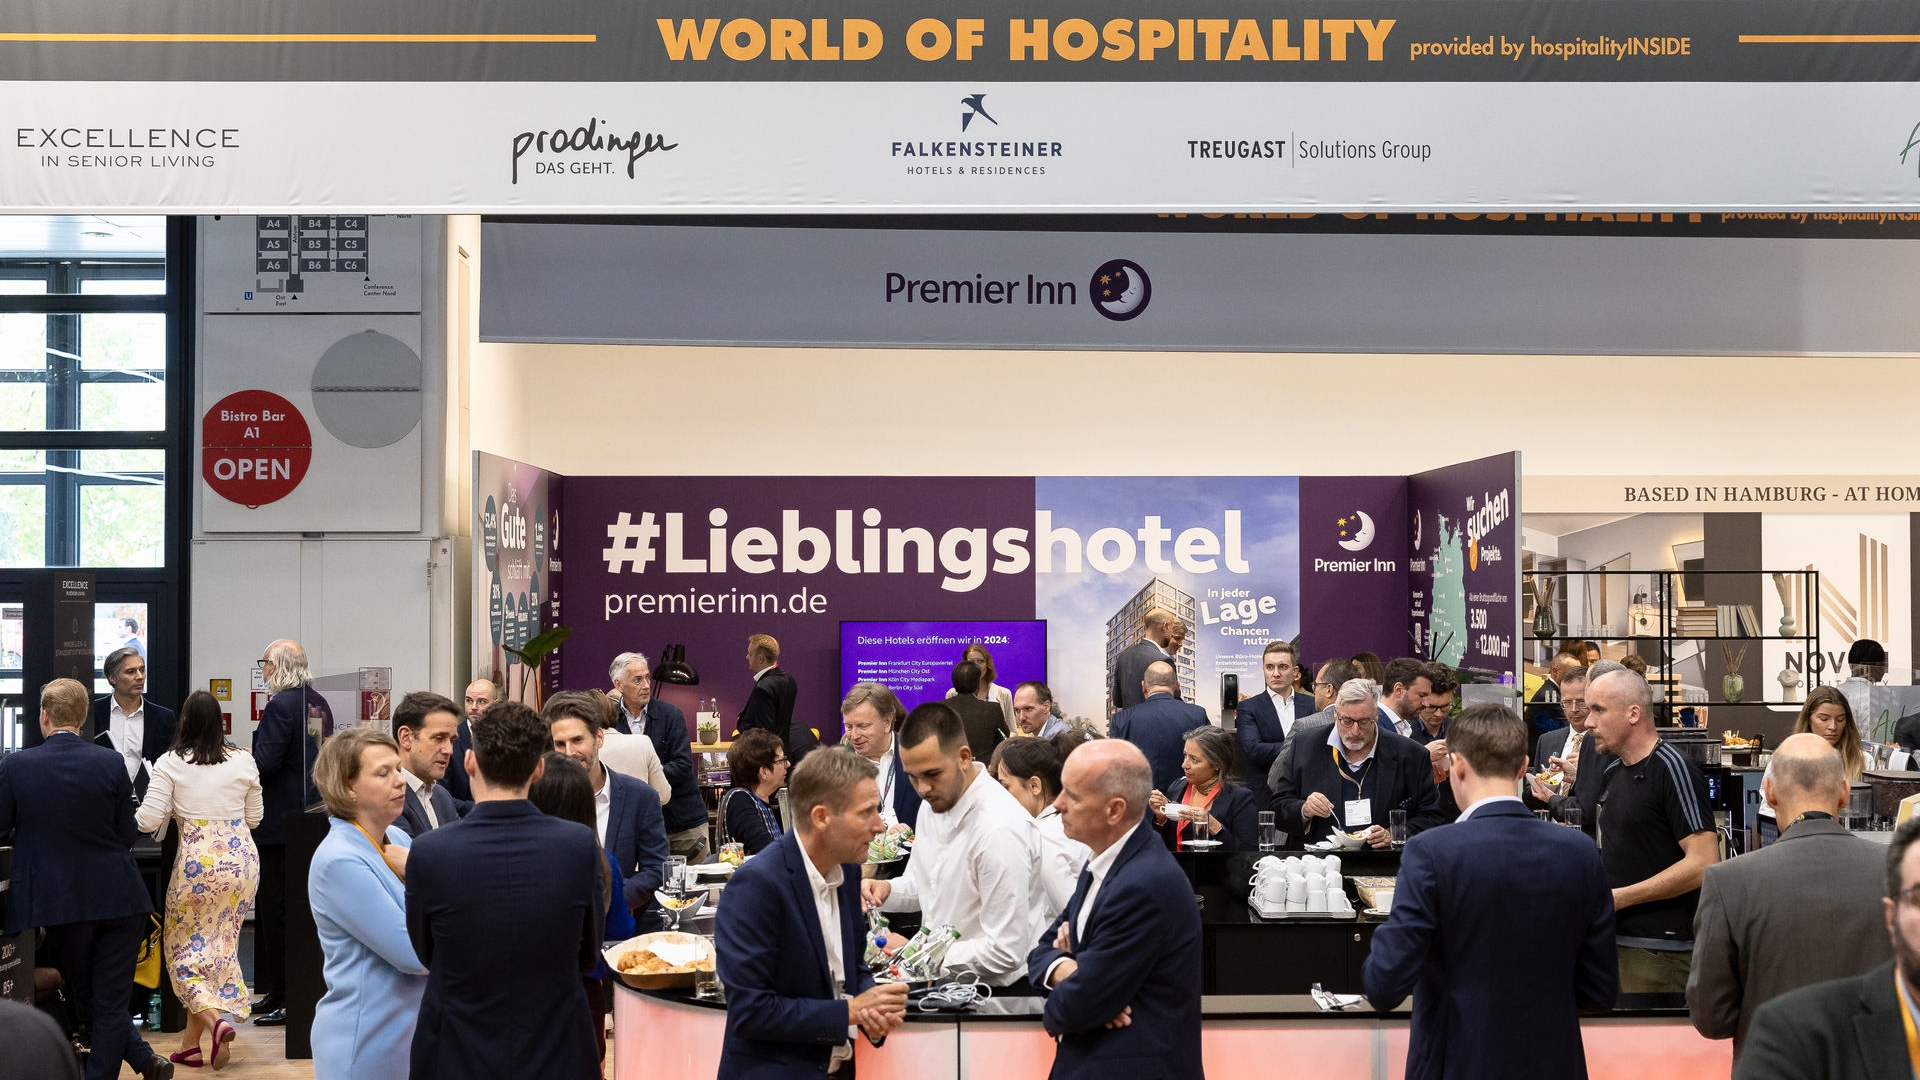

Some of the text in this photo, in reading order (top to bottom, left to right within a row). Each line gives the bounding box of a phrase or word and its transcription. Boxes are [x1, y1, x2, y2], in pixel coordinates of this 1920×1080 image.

[656, 18, 1691, 61] WORLD OF HOSPITALITY provided by hospitalityINSIDE
[17, 128, 240, 148] EXCELLENCE
[512, 117, 679, 185] prodinger
[891, 142, 1063, 157] FALKENSTEINER
[1187, 140, 1431, 163] TREUGAST Solutions Group
[41, 155, 215, 167] IN SENIOR LIVING
[535, 162, 615, 174] DAS GEHT.
[907, 166, 1046, 175] HOTELS & RESIDENCES
[266, 219, 281, 228] A4
[308, 219, 322, 228] B4
[344, 219, 358, 228] C4
[266, 240, 281, 249] A5
[308, 240, 322, 249] B5
[344, 240, 358, 249] C5
[266, 261, 281, 270] A6
[308, 261, 322, 270] B6
[344, 261, 358, 270] C6
[885, 272, 1077, 305] Premier Inn
[245, 292, 253, 300] U
[221, 410, 286, 422] Bistro Bar
[243, 427, 260, 439] A1
[213, 458, 291, 480] OPEN
[1624, 487, 1689, 502] BASED
[1695, 487, 1717, 502] IN
[1724, 487, 1827, 502] HAMBURG
[1844, 487, 1870, 501] AT
[1466, 495, 1475, 511] Wir
[1467, 488, 1509, 548] suchen
[501, 502, 526, 550] Gute
[602, 507, 1250, 593] #Lieblingshotel
[1481, 545, 1502, 566] Projekte.
[1314, 558, 1396, 572] Premier Inn
[62, 581, 89, 589] EXCELLENCE
[1207, 588, 1251, 600] In jeder
[605, 587, 828, 620] premierinn.de
[1200, 595, 1277, 625] Lage
[1470, 608, 1487, 629] 3.500
[1220, 626, 1270, 636] Chancen
[857, 635, 1010, 645] Diese Hotels eröffnen wir in 2024:
[1480, 634, 1500, 657] 12.000
